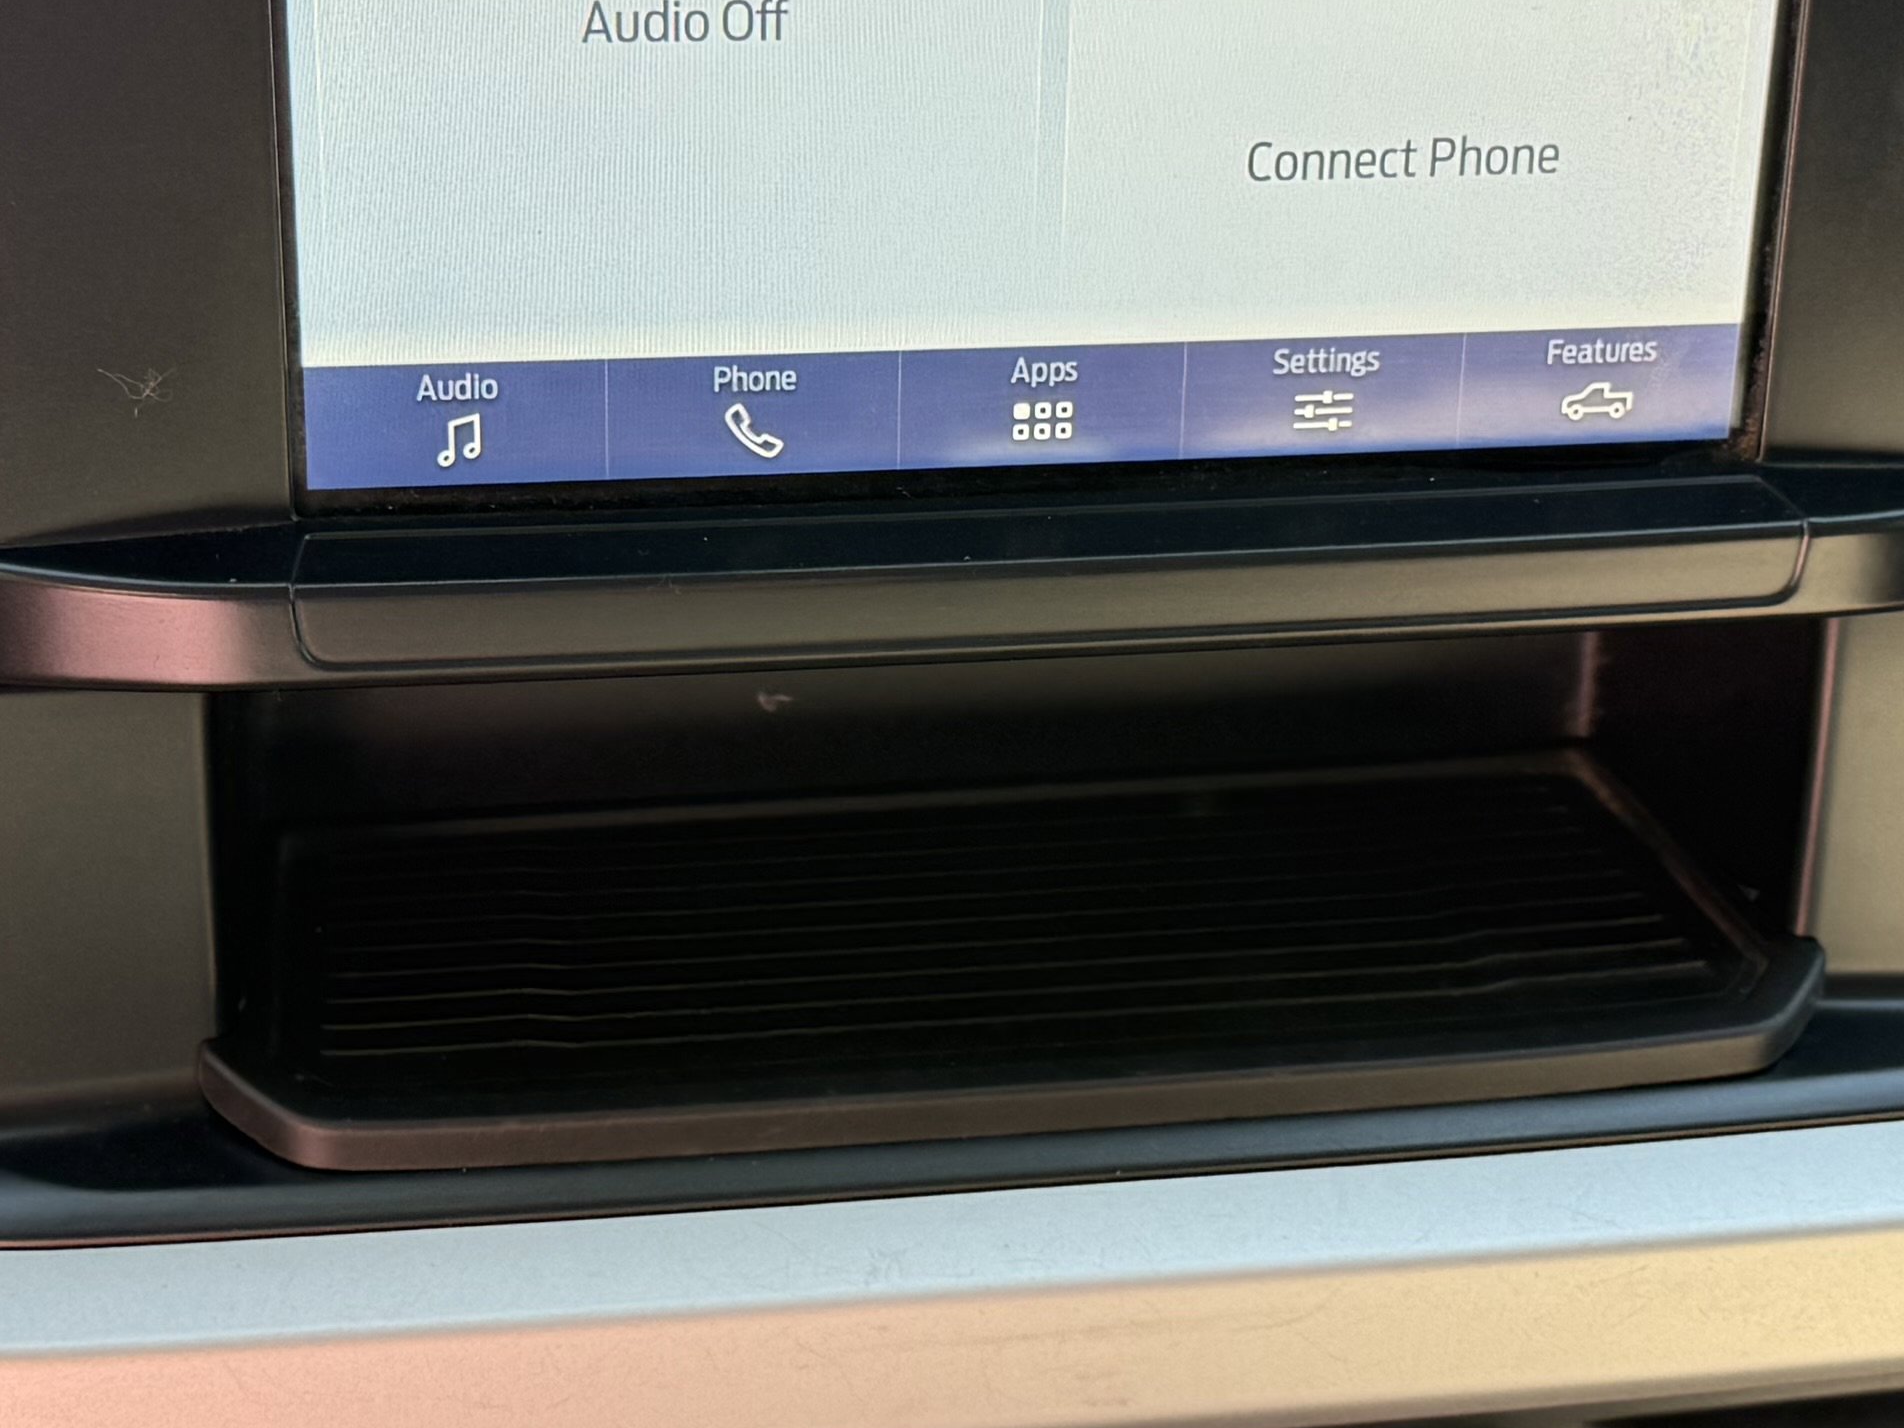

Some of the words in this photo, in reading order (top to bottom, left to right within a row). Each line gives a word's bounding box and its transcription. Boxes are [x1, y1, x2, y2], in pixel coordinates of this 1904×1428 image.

[582, 0, 710, 44] Audio
[1247, 138, 1419, 182] Connect
[1429, 134, 1561, 179] Phone
[1273, 346, 1381, 378] Settings
[1546, 337, 1659, 367] Features
[416, 373, 499, 403] Audio
[713, 365, 798, 394] Phone
[1010, 356, 1079, 388] Apps
